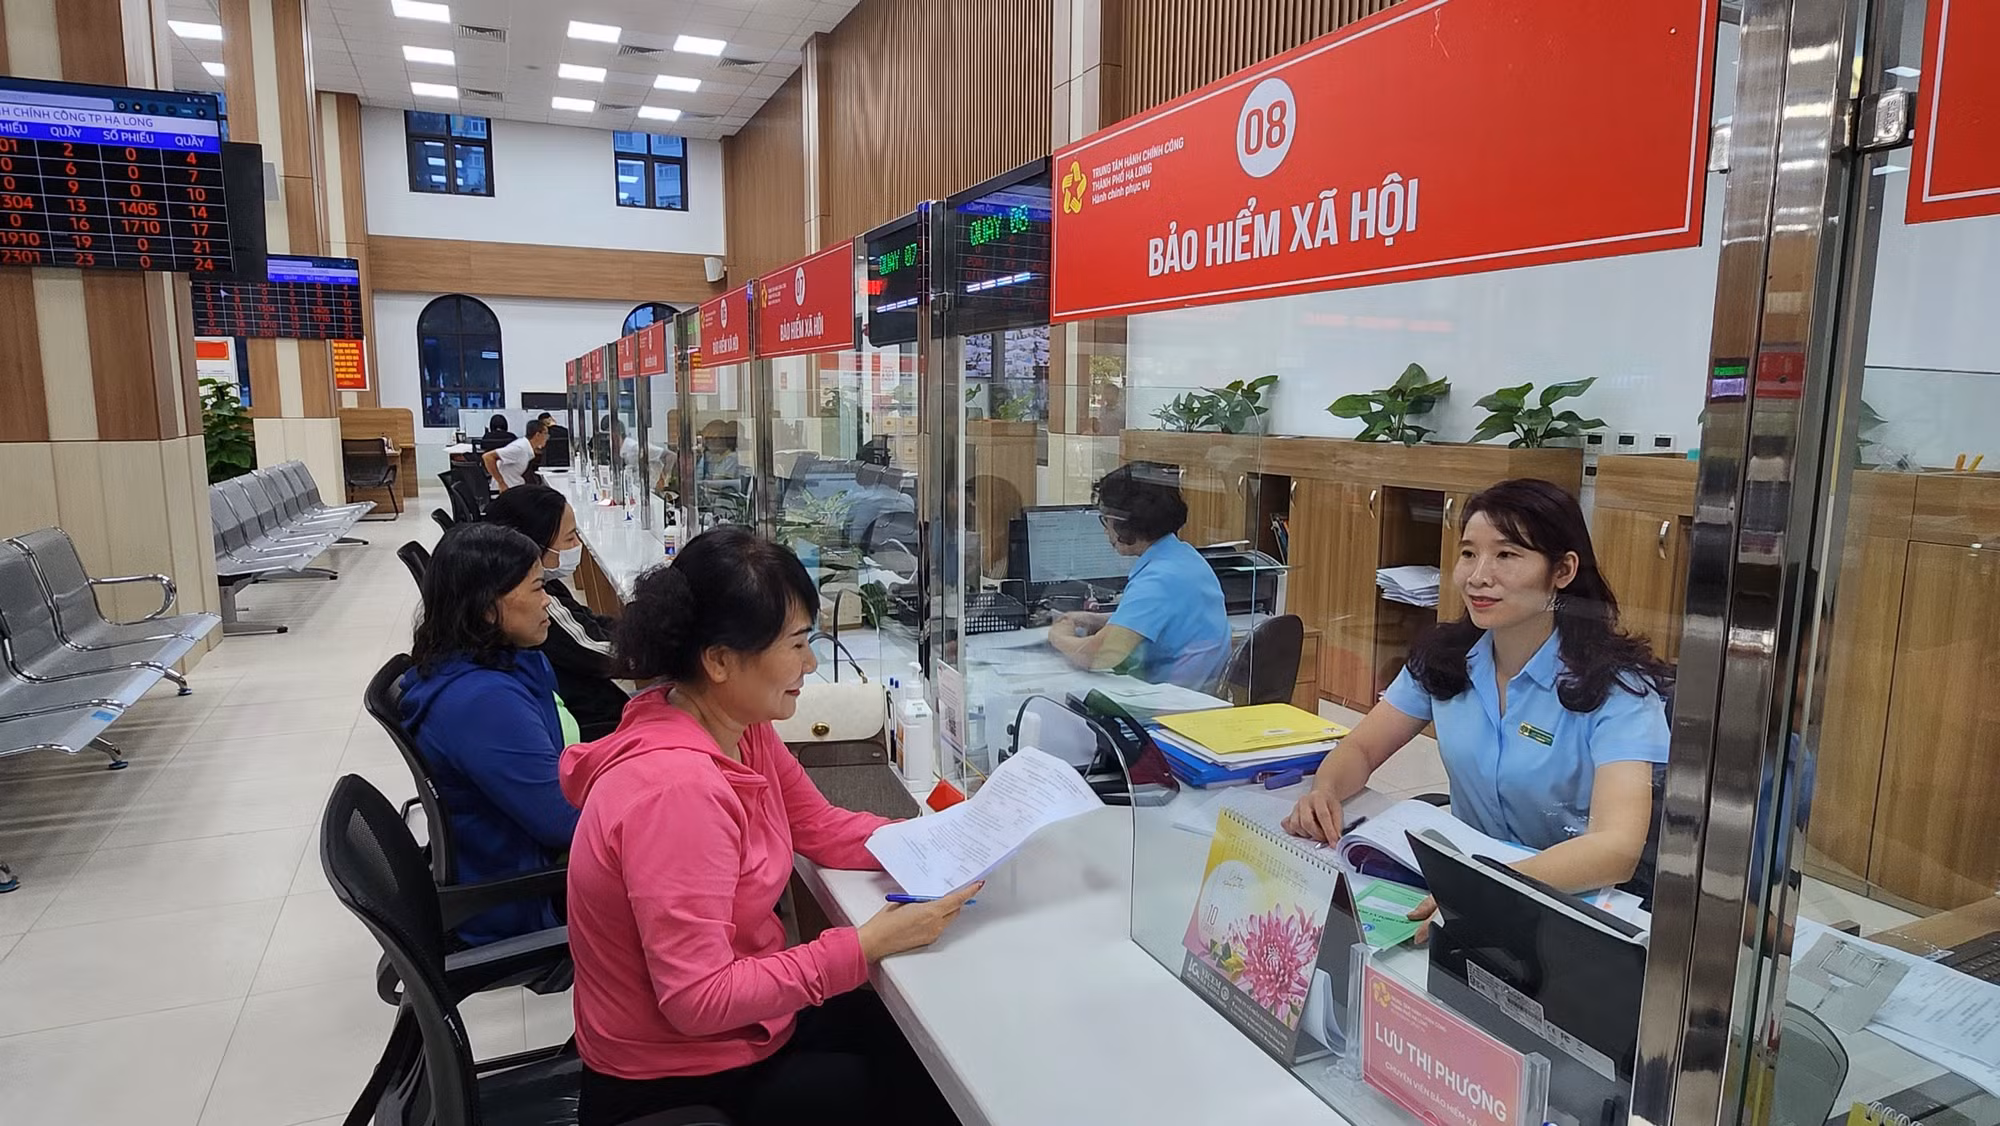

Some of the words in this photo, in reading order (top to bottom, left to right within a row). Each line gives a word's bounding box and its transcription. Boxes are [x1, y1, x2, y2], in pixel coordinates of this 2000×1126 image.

[0, 106, 10, 115] H
[13, 105, 51, 119] CHÍNH
[53, 110, 86, 122] CÔNG
[88, 113, 102, 121] TP
[104, 115, 120, 127] HẠ
[123, 116, 153, 127] LONG
[1243, 99, 1288, 158] 08
[50, 124, 82, 138] QUẦY
[103, 128, 119, 141] SỐ
[121, 131, 154, 143] PHIẾU
[175, 133, 204, 147] QUẦY
[64, 143, 74, 156] 2
[126, 147, 137, 161] 0
[186, 152, 197, 164] 4
[1092, 163, 1111, 178] TRUNG
[1112, 159, 1123, 172] TÂM
[1124, 154, 1142, 170] HÀNH
[1142, 145, 1164, 161] CHÍNH
[1164, 137, 1184, 154] CÔNG
[1, 157, 12, 171] 0
[66, 162, 77, 175] 6
[128, 165, 139, 179] 0
[188, 170, 198, 182] 7
[1092, 178, 1112, 192] THÀNH
[1112, 169, 1125, 187] PHỐ
[1125, 170, 1135, 182] HẠ
[1134, 162, 1152, 178] LONG
[4, 176, 15, 190] 0
[68, 180, 79, 193] 9
[130, 184, 141, 197] 0
[186, 188, 206, 201] 10
[1091, 193, 1107, 205] Hành
[1108, 185, 1125, 200] chính
[1125, 183, 1141, 197] phục
[1141, 179, 1151, 191] vụ
[67, 199, 87, 212] 13
[119, 202, 158, 216] 1405
[188, 206, 208, 218] 14
[10, 213, 21, 227] 0
[70, 218, 90, 230] 16
[122, 220, 160, 234] 1710
[192, 224, 209, 236] 17
[970, 212, 1002, 247] QUAY
[1147, 220, 1198, 278] BẢO
[1205, 197, 1281, 267] HIỂM
[1288, 188, 1339, 254] XÃ
[1349, 172, 1419, 248] HỘI
[0, 232, 40, 246] 1910
[72, 235, 92, 248] 19
[137, 238, 148, 251] 0
[193, 241, 210, 253] 21
[904, 243, 917, 267] 07
[1, 250, 40, 264] 2301
[74, 253, 95, 266] 23
[140, 255, 151, 268] 0
[195, 258, 214, 270] 24
[796, 276, 804, 297] 07
[780, 318, 790, 342] BẢO
[790, 312, 804, 340] HIỂM
[804, 314, 813, 337] XÃ
[813, 311, 824, 340] HỘI
[1207, 904, 1219, 926] 10
[1375, 1021, 1404, 1055] LƯU
[1406, 1042, 1432, 1080] THỊ
[1435, 1060, 1507, 1122] PHƯỢNG
[1385, 1061, 1412, 1085] CHUYÊN
[1413, 1080, 1430, 1097] VIÊN
[1430, 1091, 1446, 1108] BẢO
[1446, 1103, 1466, 1120] HIỂM
